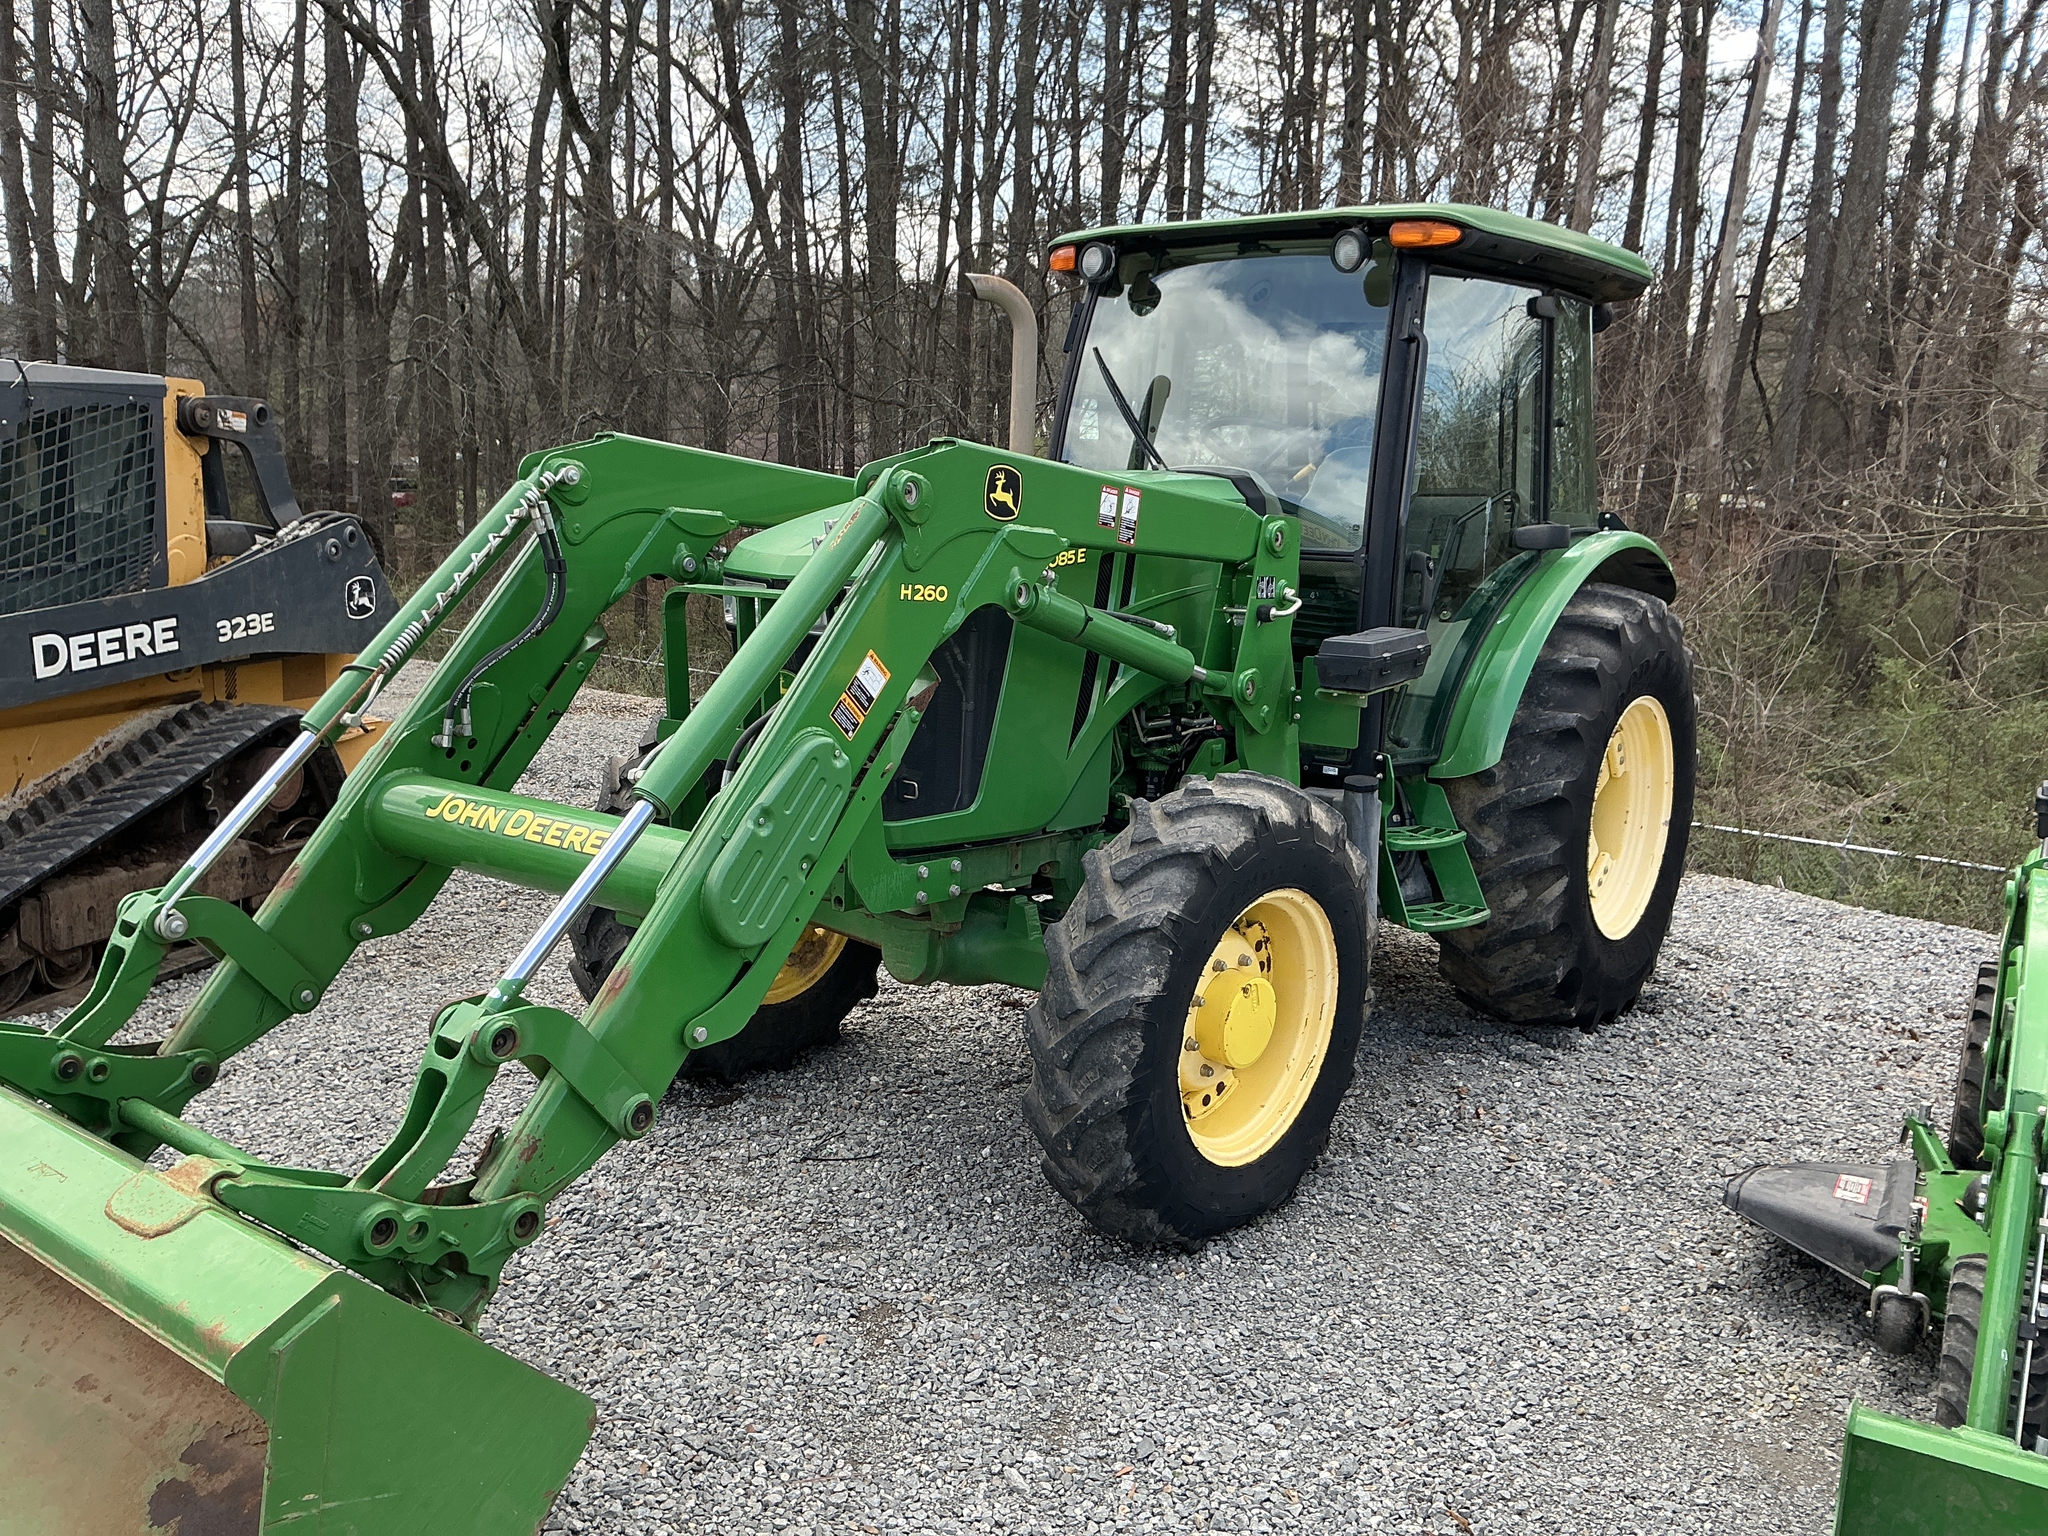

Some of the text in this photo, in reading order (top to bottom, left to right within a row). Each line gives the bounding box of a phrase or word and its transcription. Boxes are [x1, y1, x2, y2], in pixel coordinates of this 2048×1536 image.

[900, 583, 949, 602] H260
[32, 612, 275, 680] DEERE 323E
[425, 793, 614, 856] JOHN DEERE
